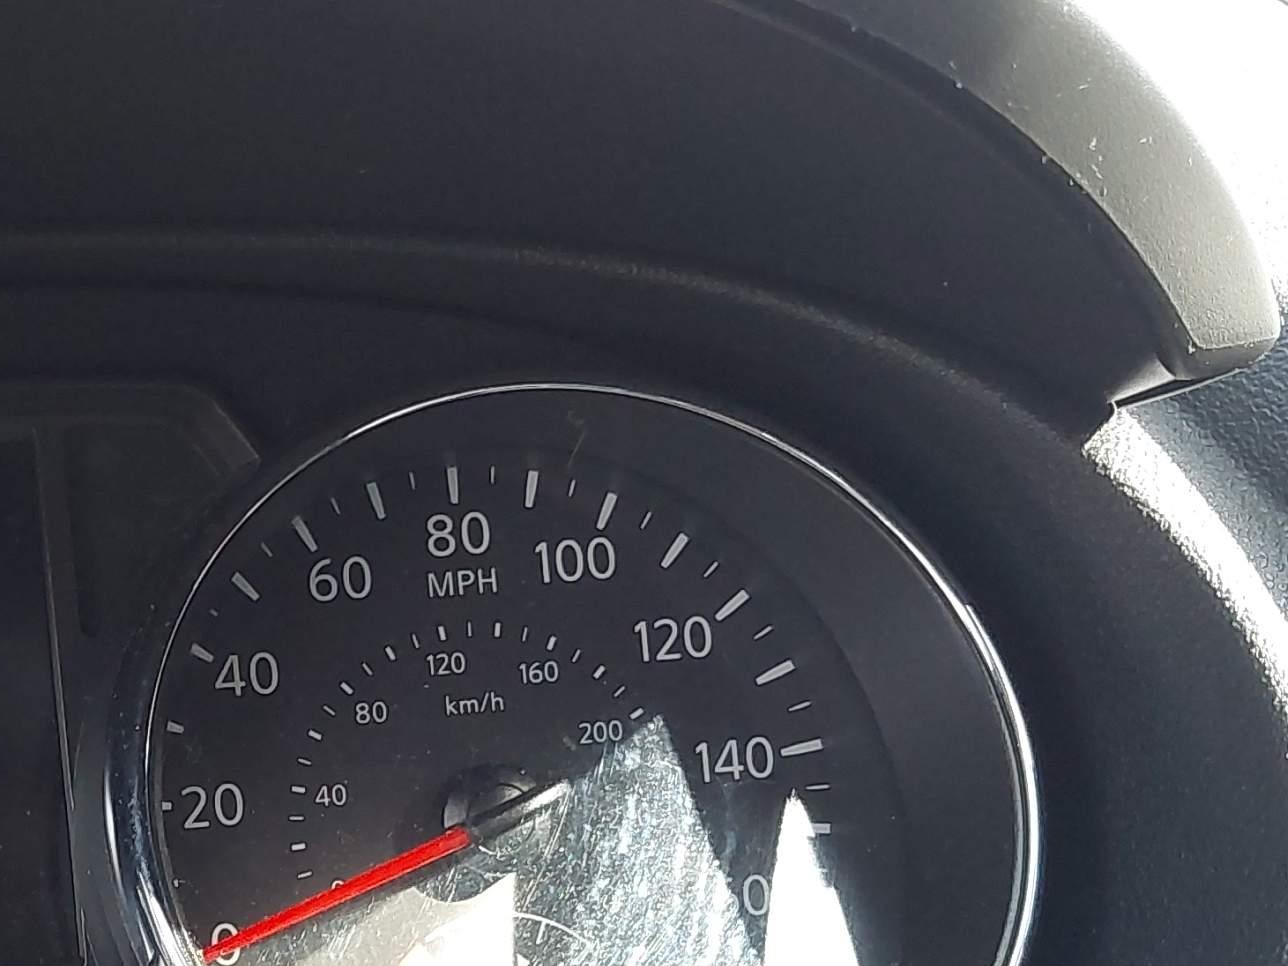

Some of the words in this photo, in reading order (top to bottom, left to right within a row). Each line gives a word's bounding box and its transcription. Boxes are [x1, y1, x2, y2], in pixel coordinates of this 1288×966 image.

[426, 511, 491, 557] 80
[308, 555, 372, 602] 60
[534, 536, 616, 584] 100
[427, 567, 498, 599] MPH
[633, 615, 713, 662] 120
[214, 651, 279, 697] 40
[426, 651, 466, 677] 120
[519, 660, 559, 684] 160
[355, 701, 388, 724] 80
[445, 691, 505, 716] km/h
[578, 720, 623, 745] 200
[695, 736, 774, 783] 140
[180, 782, 245, 830] 20
[314, 783, 348, 807] 40
[211, 922, 242, 966] 0
